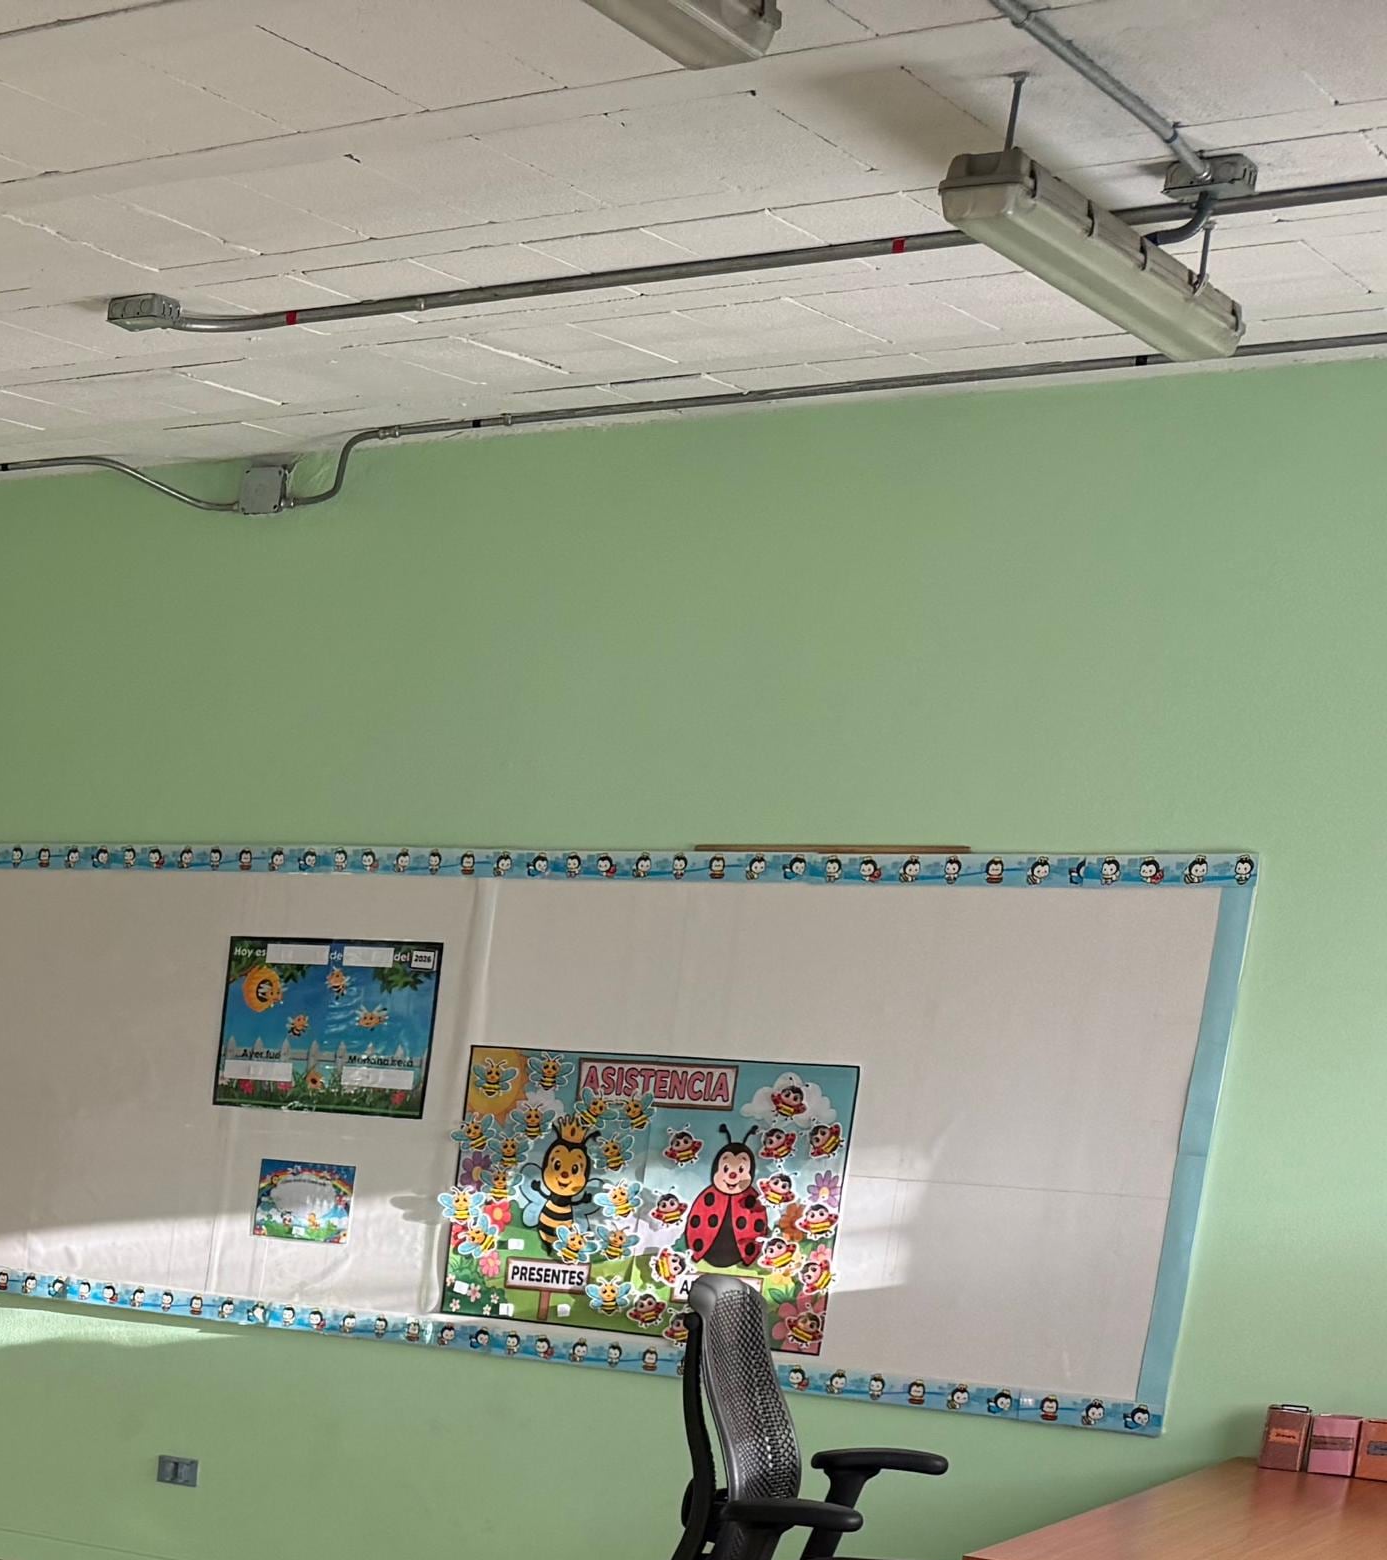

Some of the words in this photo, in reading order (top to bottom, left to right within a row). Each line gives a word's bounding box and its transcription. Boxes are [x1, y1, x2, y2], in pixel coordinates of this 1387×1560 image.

[234, 946, 253, 958] Hoy
[255, 948, 266, 957] es
[329, 951, 343, 961] de
[394, 951, 409, 962] del
[582, 1065, 730, 1103] ASISTENCIA
[511, 1265, 584, 1286] PRESENTES
